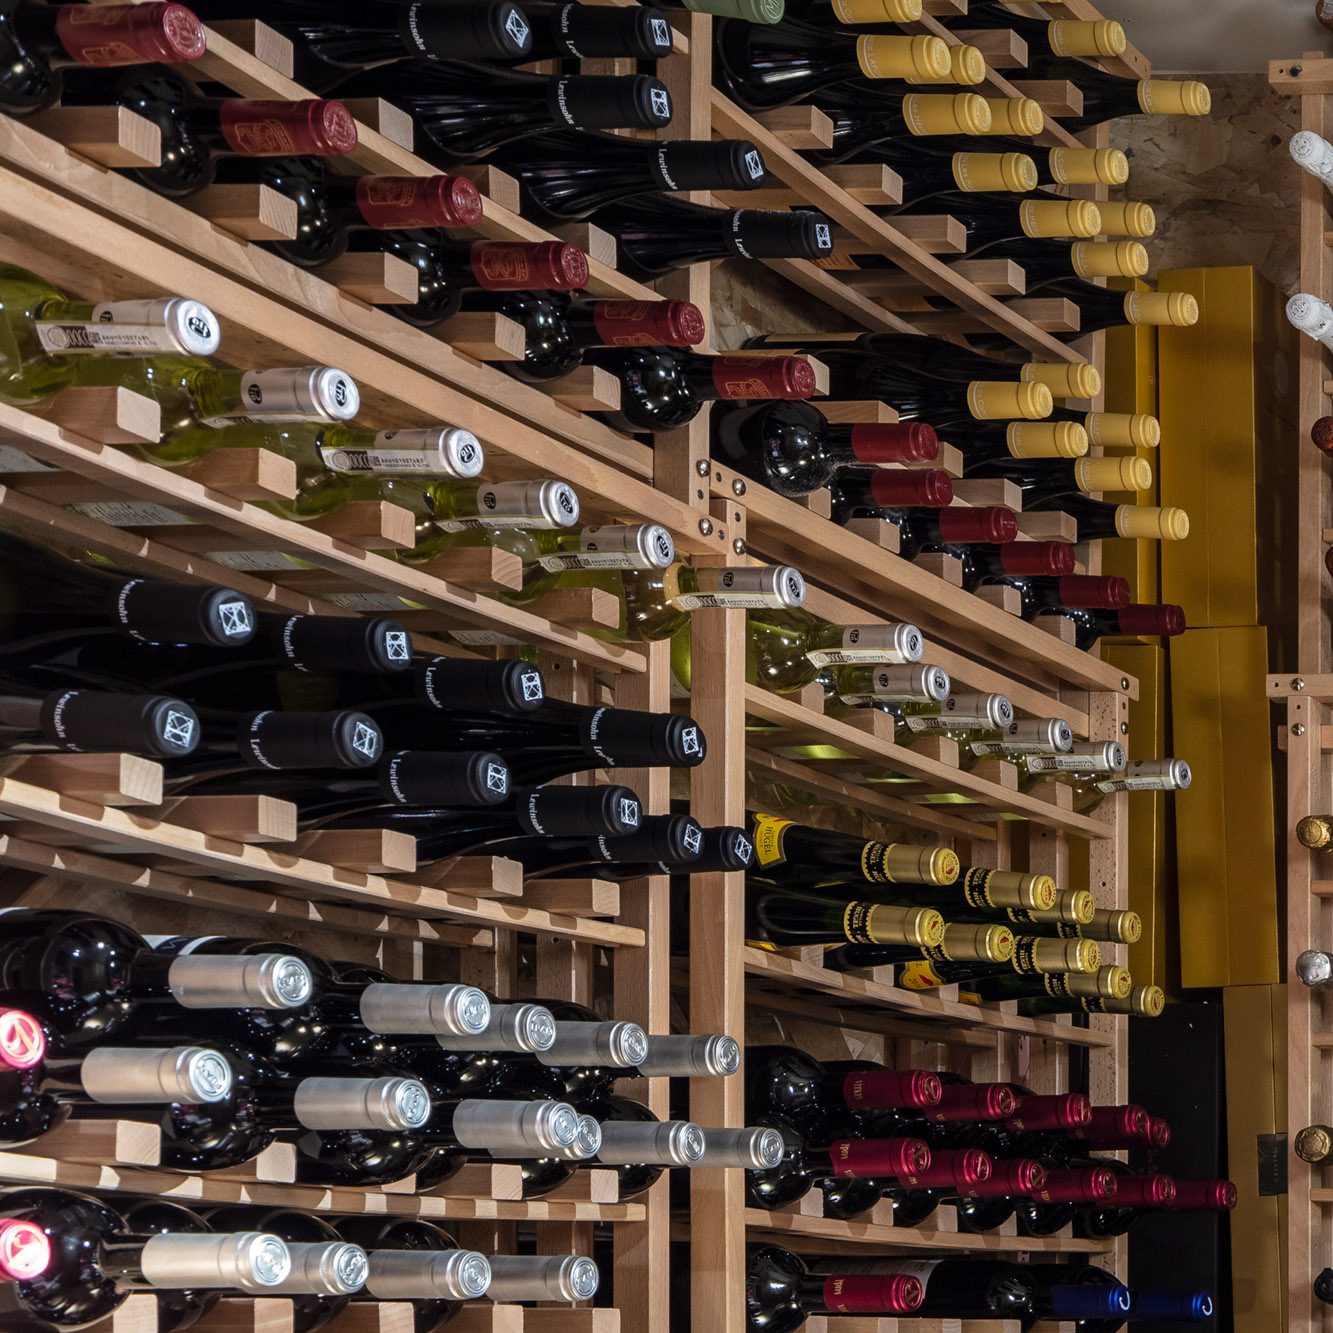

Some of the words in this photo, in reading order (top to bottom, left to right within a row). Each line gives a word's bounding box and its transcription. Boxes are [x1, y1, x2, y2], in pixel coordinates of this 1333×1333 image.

[409, 3, 426, 51] Lewinsohn
[558, 81, 574, 125] Lewinsohn
[659, 149, 678, 191] Lewinsohn
[118, 579, 144, 624] Lewinsohn
[283, 615, 302, 658] Lewinsohn
[426, 666, 443, 708] Lewinsohn
[54, 691, 79, 738] Lewinsohn
[390, 759, 407, 803] Lewinsohn
[528, 794, 545, 834] Lewinsohn
[763, 826, 773, 855] HUGEL
[853, 906, 862, 929] HUGEL
[1020, 950, 1030, 970] HUGEL
